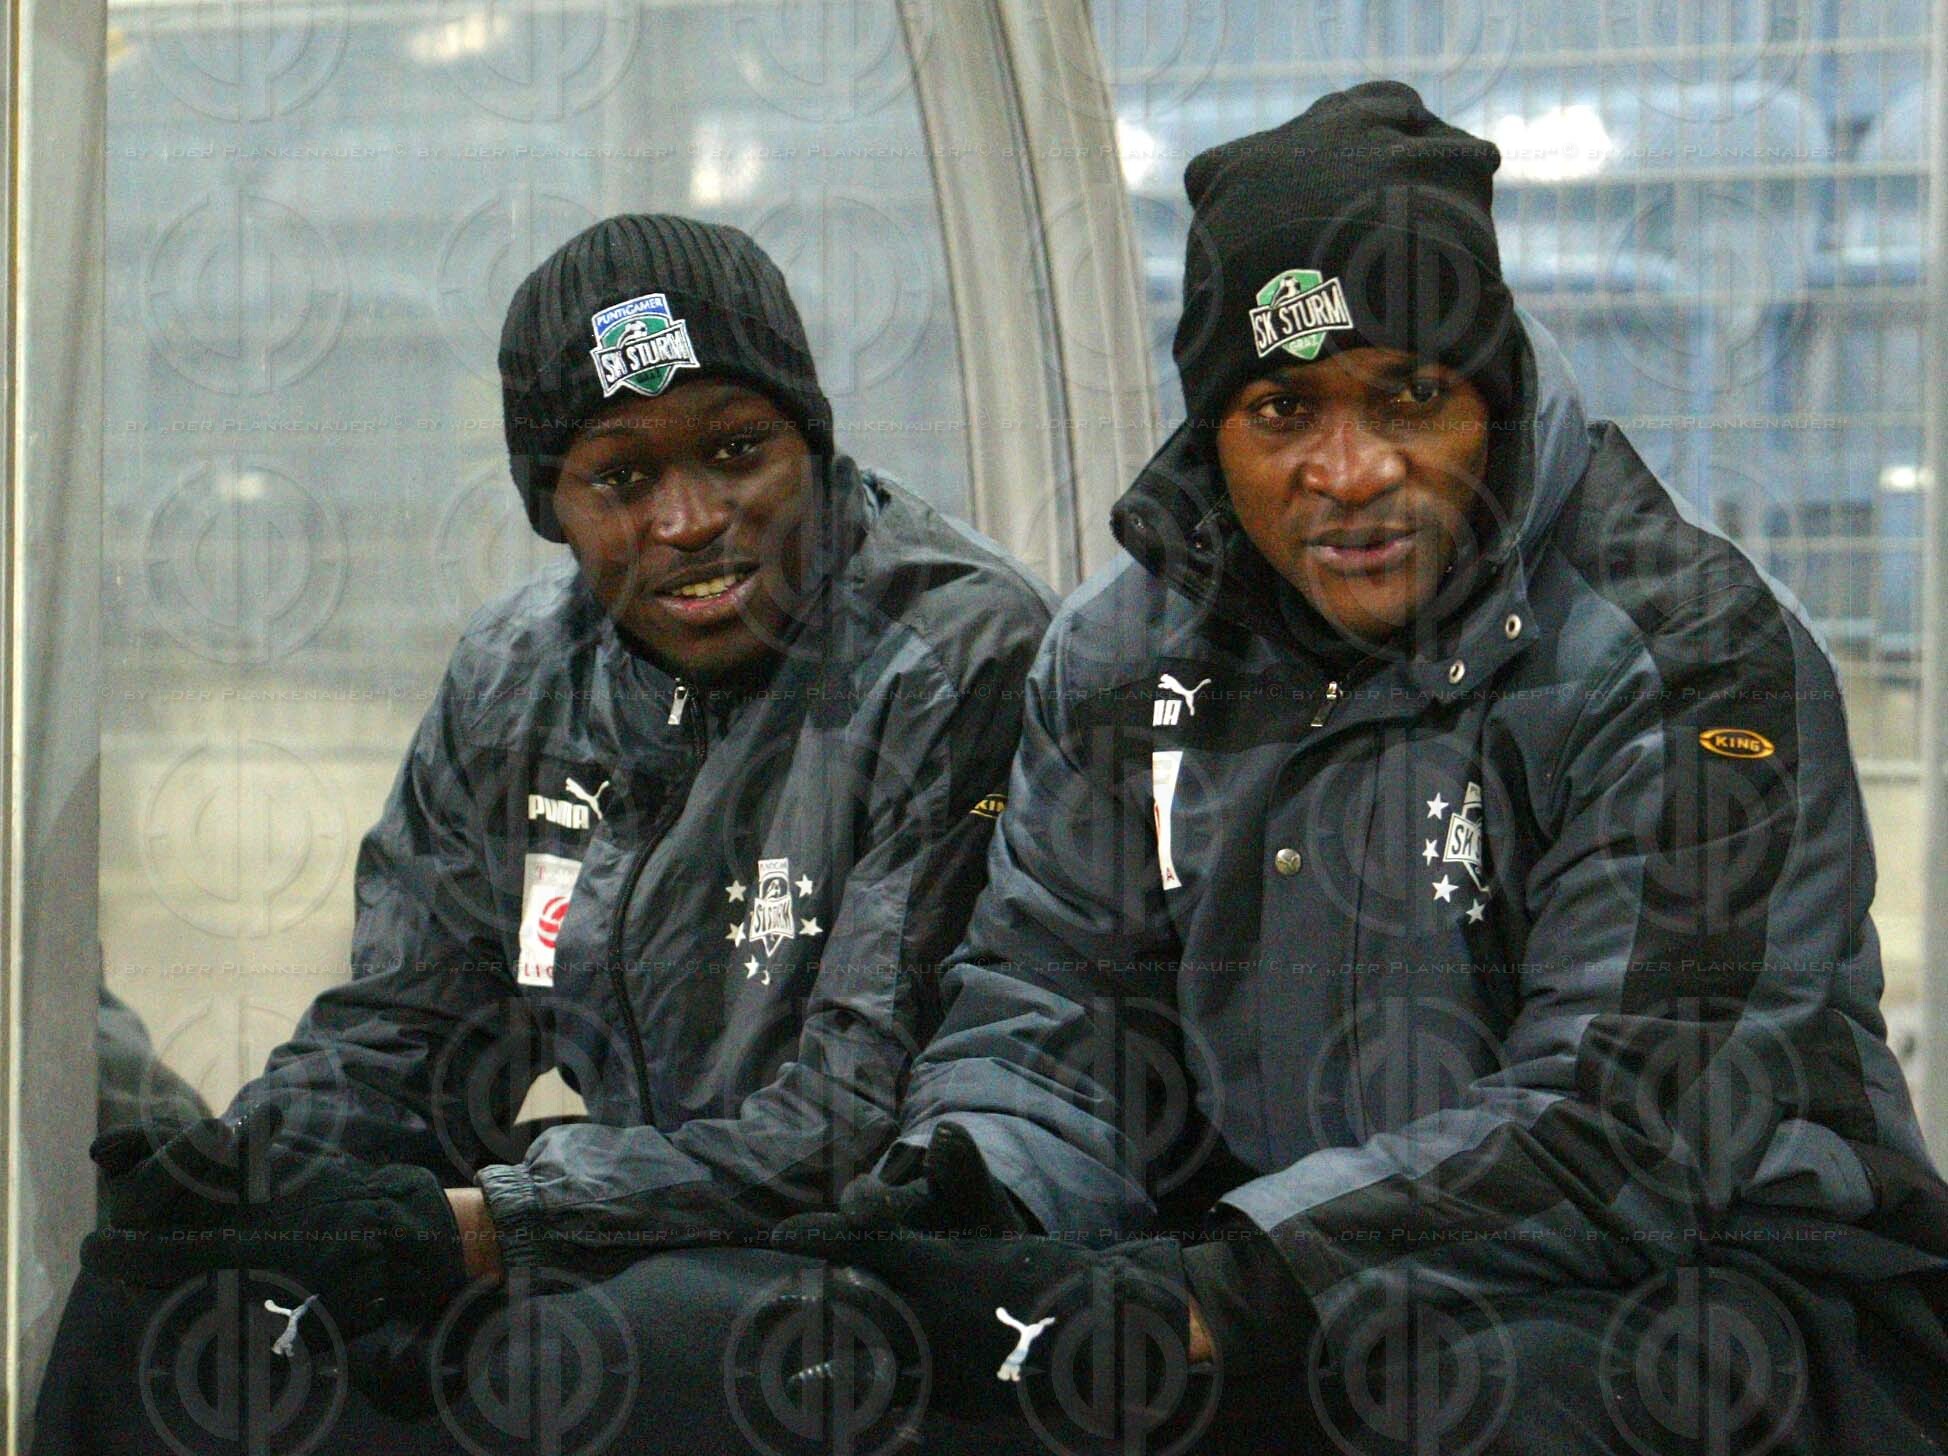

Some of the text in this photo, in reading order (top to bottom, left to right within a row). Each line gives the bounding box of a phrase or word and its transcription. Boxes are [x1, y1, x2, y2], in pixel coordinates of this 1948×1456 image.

[597, 298, 664, 326] PUNTIGAMER
[1255, 285, 1348, 349] SK STURM
[626, 331, 690, 370] STURM
[1716, 735, 1760, 752] KING
[528, 795, 589, 829] PUMA
